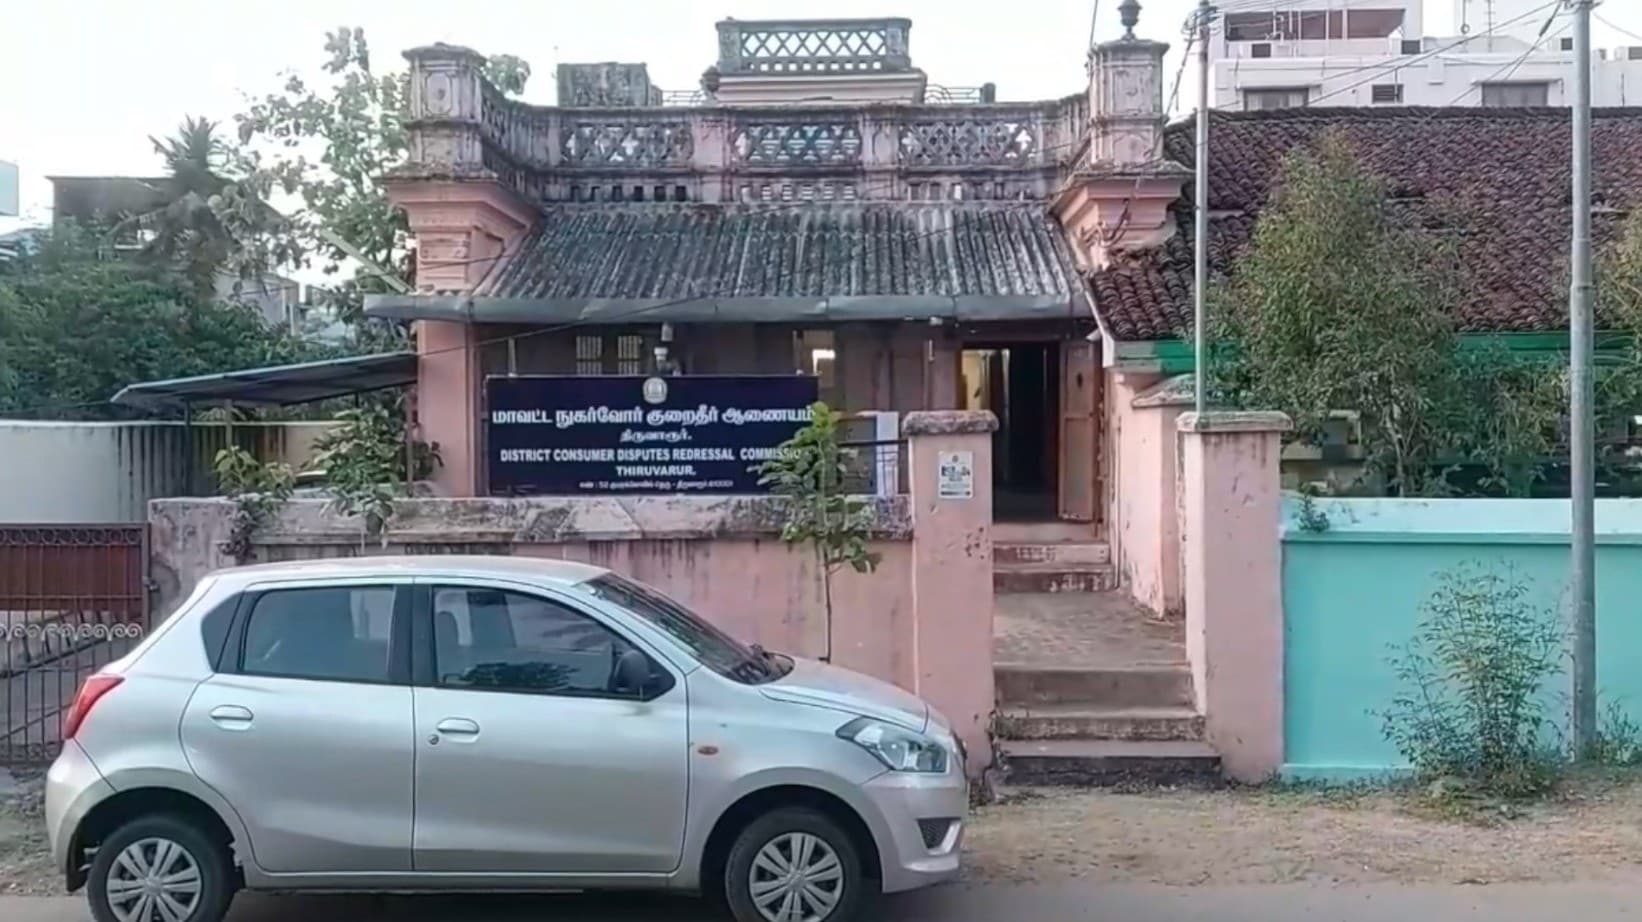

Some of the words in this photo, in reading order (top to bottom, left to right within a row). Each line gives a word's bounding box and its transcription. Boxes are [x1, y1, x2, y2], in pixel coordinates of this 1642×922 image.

[493, 408, 553, 424] மாவட்ட
[555, 406, 644, 429] நுகர்வோர்
[646, 404, 719, 427] குறைதீர்
[501, 449, 550, 461] DISTRICT
[553, 449, 614, 461] CONSUMER
[617, 448, 670, 461] DISPUTES
[673, 448, 735, 460] REDRESSAL
[740, 448, 803, 460] COMMISSIO
